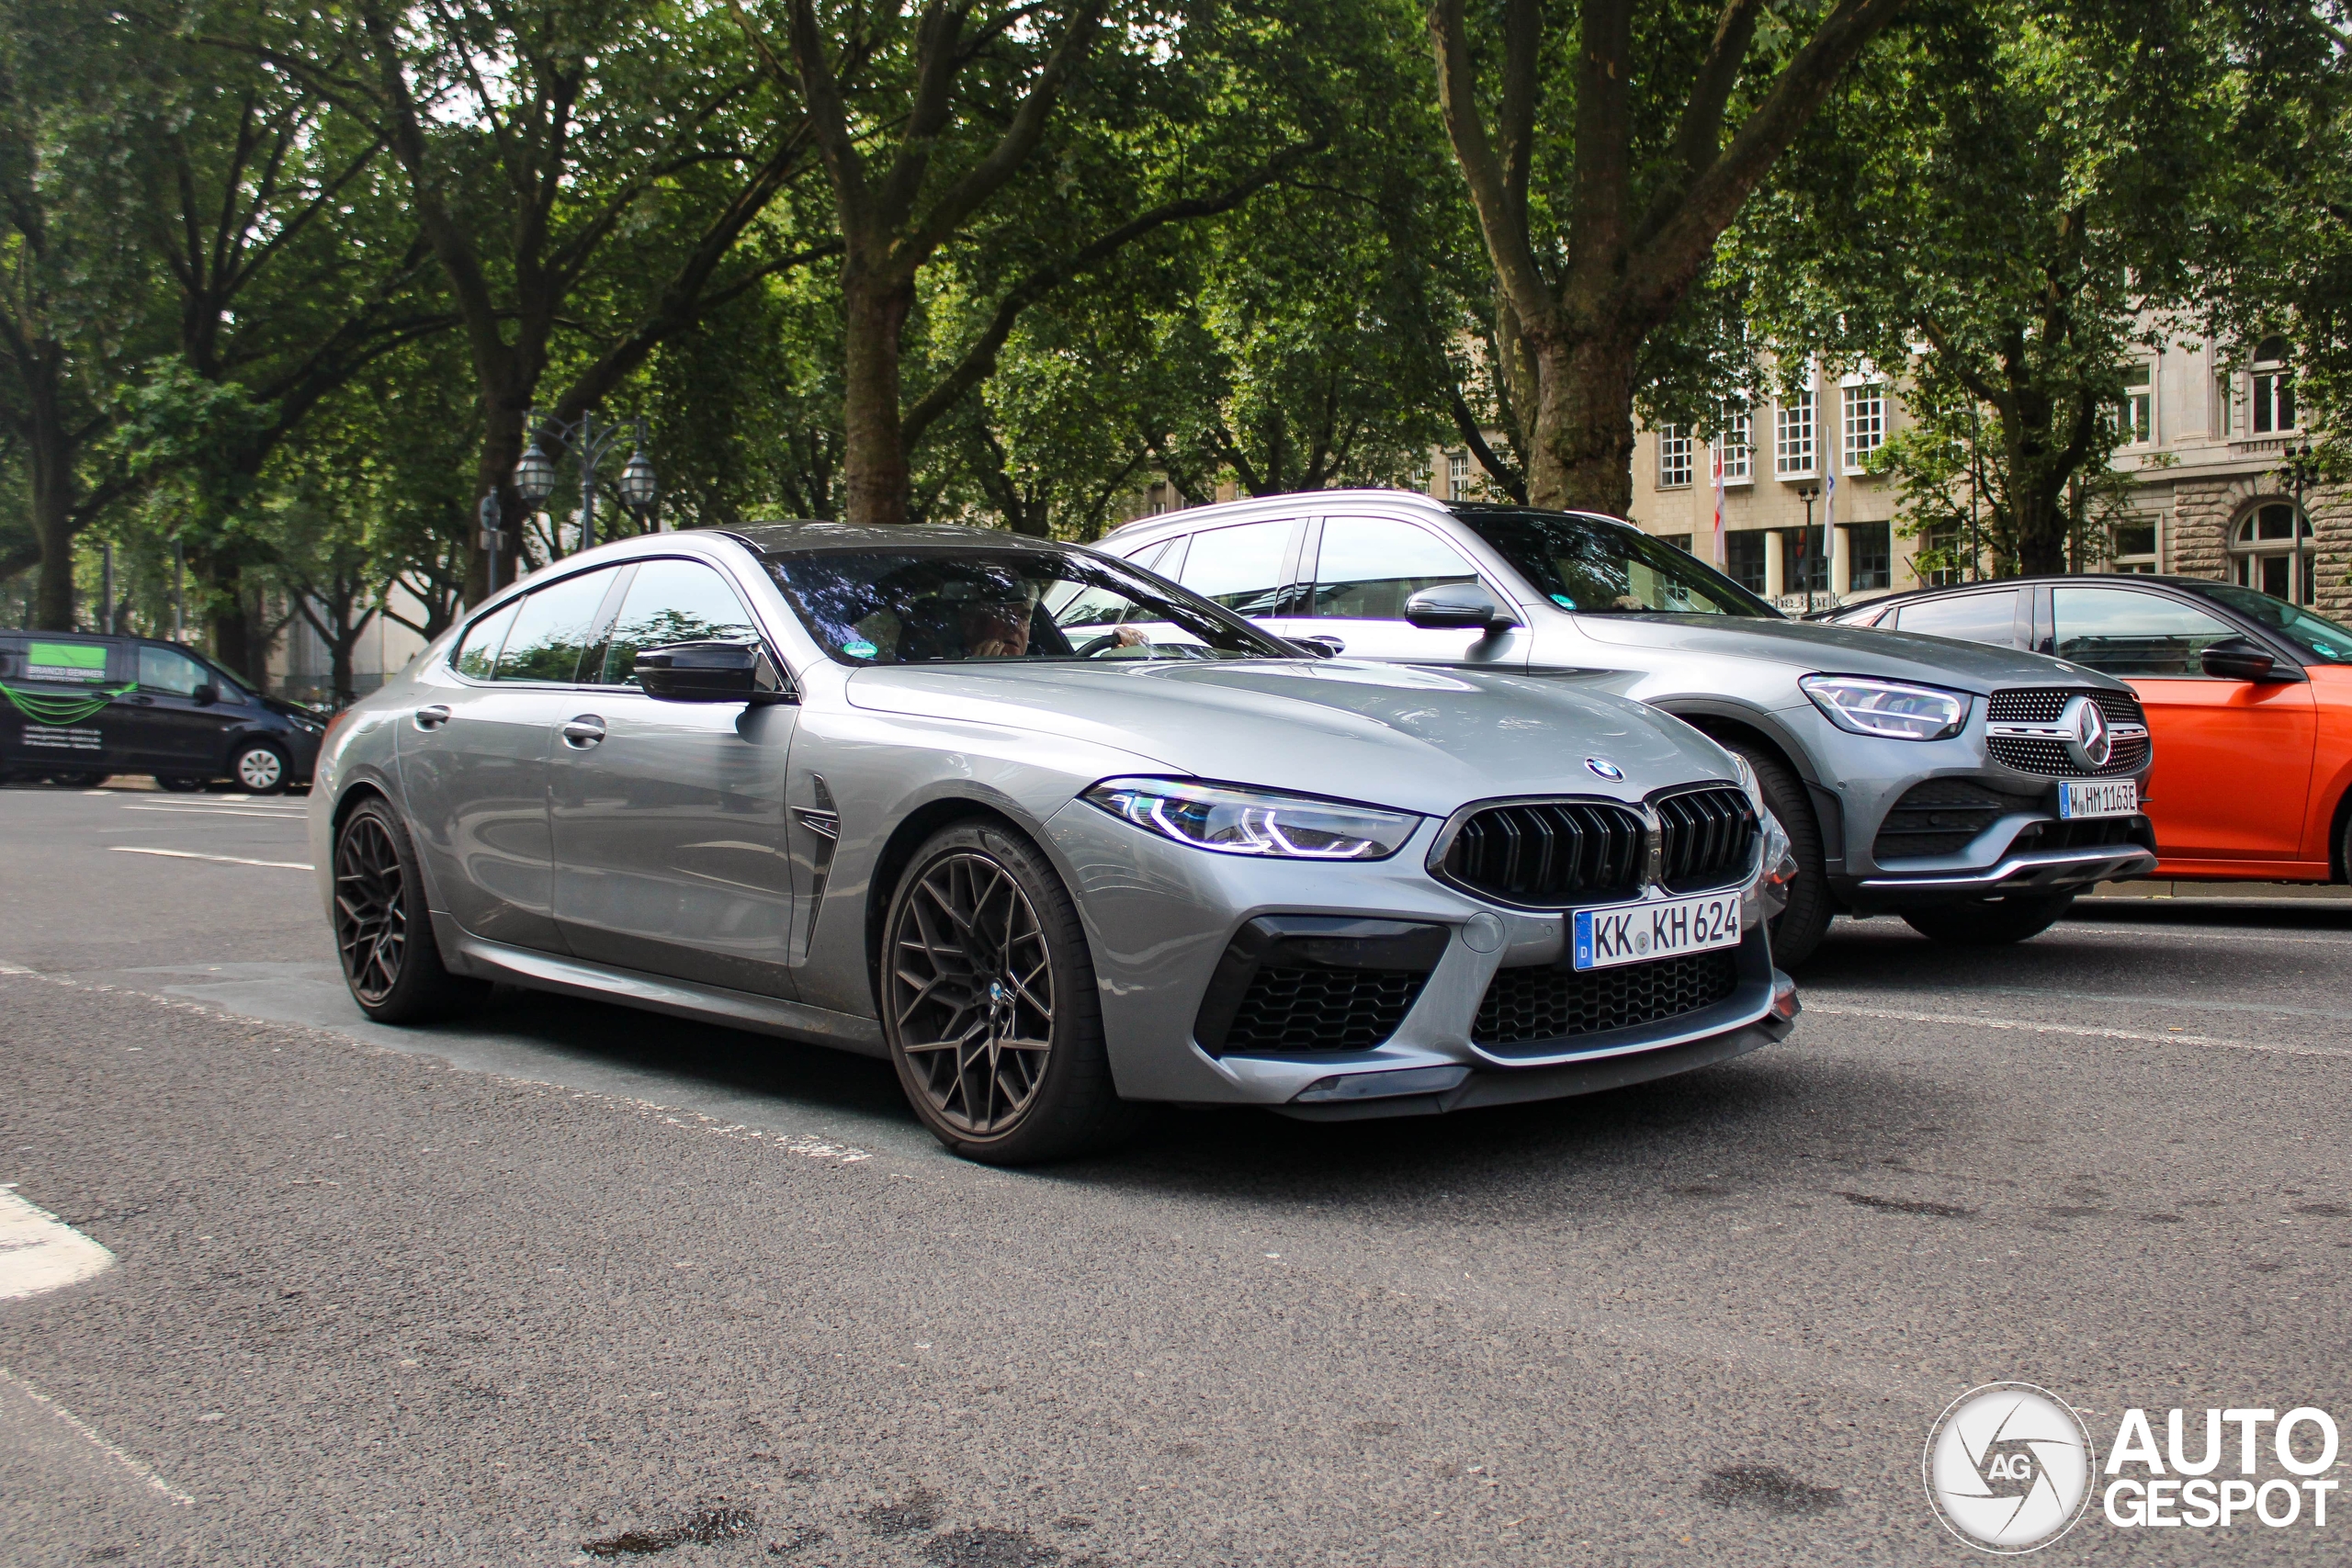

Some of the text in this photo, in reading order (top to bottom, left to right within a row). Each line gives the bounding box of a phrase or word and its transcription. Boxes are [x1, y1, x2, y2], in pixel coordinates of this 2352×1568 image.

[1799, 592, 1842, 607] Bank
[2069, 786, 2077, 813] W
[2085, 786, 2101, 812] HM
[2103, 784, 2136, 811] 1163E
[1580, 898, 1737, 959] D KK KH 624
